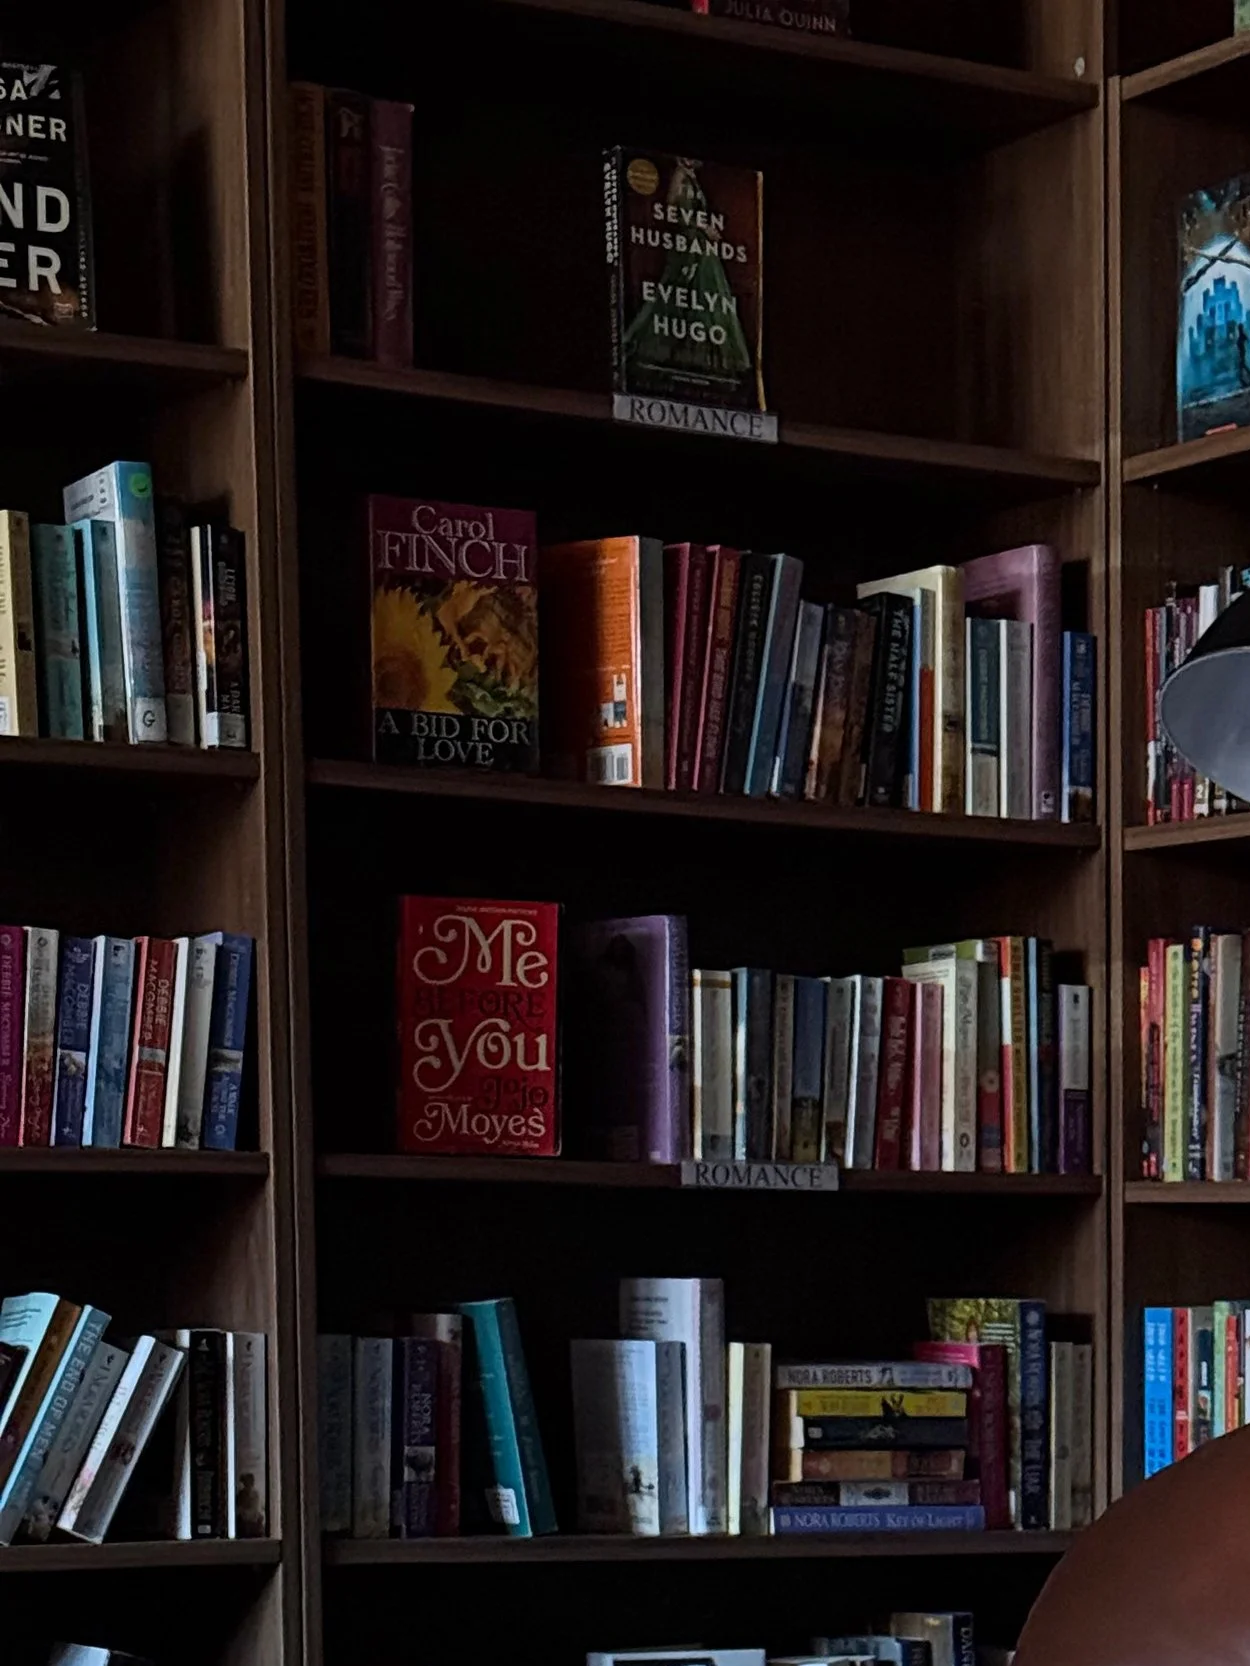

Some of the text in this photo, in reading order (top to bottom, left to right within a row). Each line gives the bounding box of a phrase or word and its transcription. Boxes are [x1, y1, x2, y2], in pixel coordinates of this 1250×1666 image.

[779, 10, 838, 34] QUINN
[653, 201, 727, 232] SEVEN
[630, 225, 748, 264] HUSBANDS
[641, 280, 738, 316] EVELYN
[653, 314, 728, 346] HUGO
[628, 397, 763, 437] ROMANCE
[411, 505, 495, 542] Carol
[376, 528, 530, 583] FINCH
[378, 712, 532, 746] A BID FOR
[415, 736, 496, 768] LOVE
[411, 913, 550, 990] Me
[413, 986, 547, 1020] BEFORE
[411, 1100, 547, 1145] Moyes
[694, 1162, 825, 1190] ROMANCE
[31, 1319, 103, 1461] THE END OF MEN
[821, 1365, 873, 1385] ROBERTS
